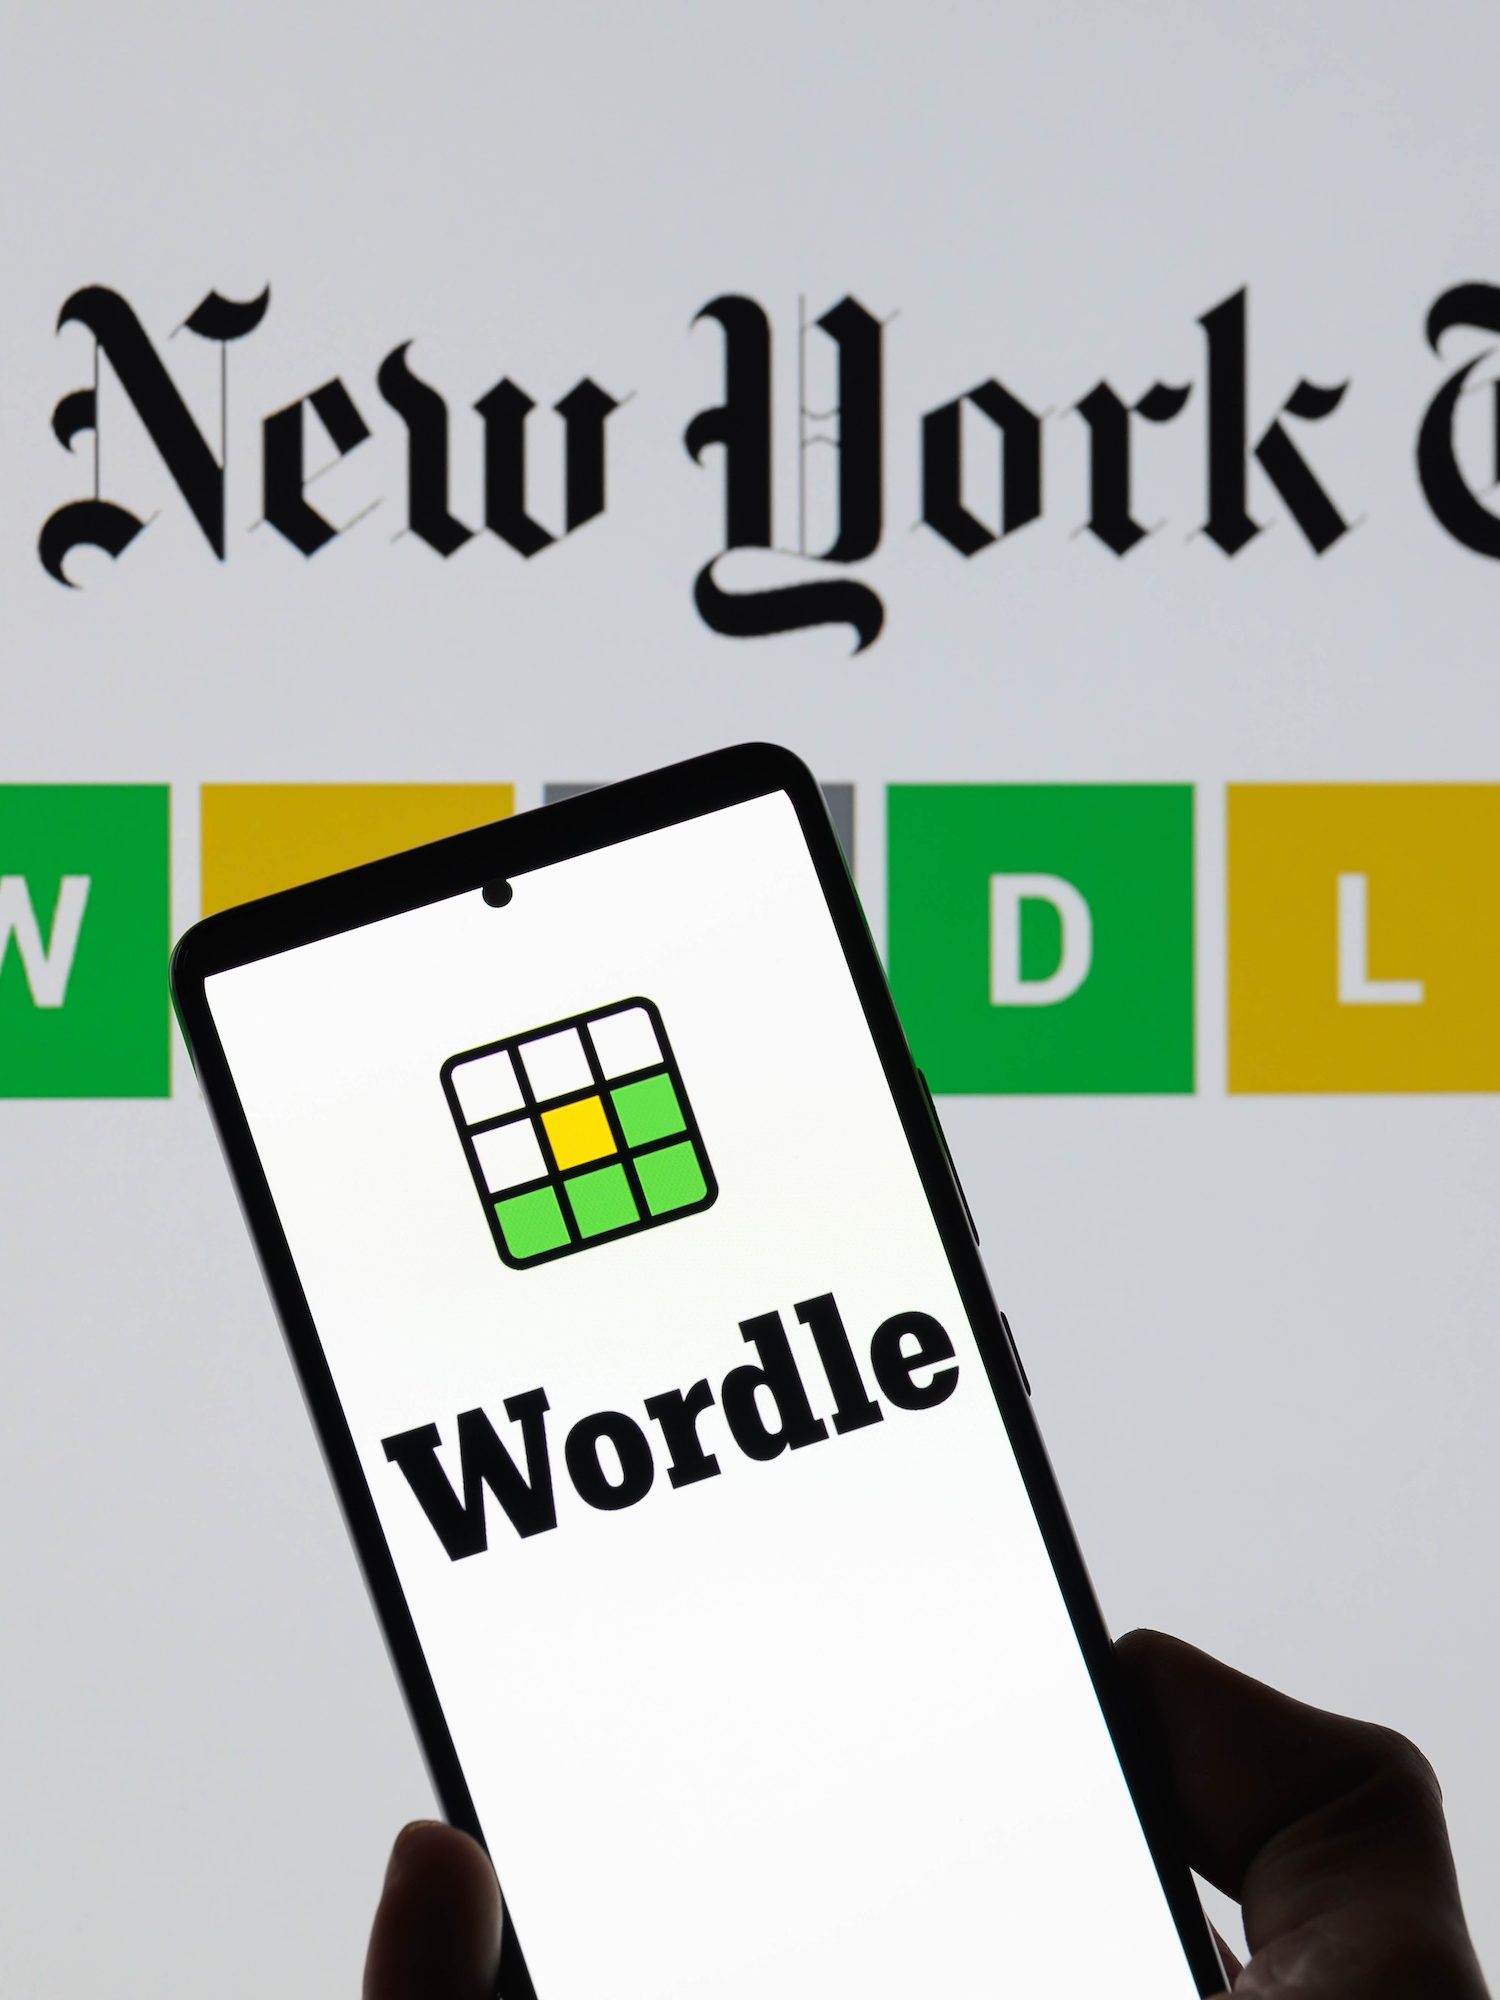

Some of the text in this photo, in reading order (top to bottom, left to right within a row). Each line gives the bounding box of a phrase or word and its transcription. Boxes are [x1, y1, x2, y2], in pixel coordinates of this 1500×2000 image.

[37, 282, 634, 589] New
[683, 284, 1364, 657] York
[381, 1292, 960, 1562] Wordle
